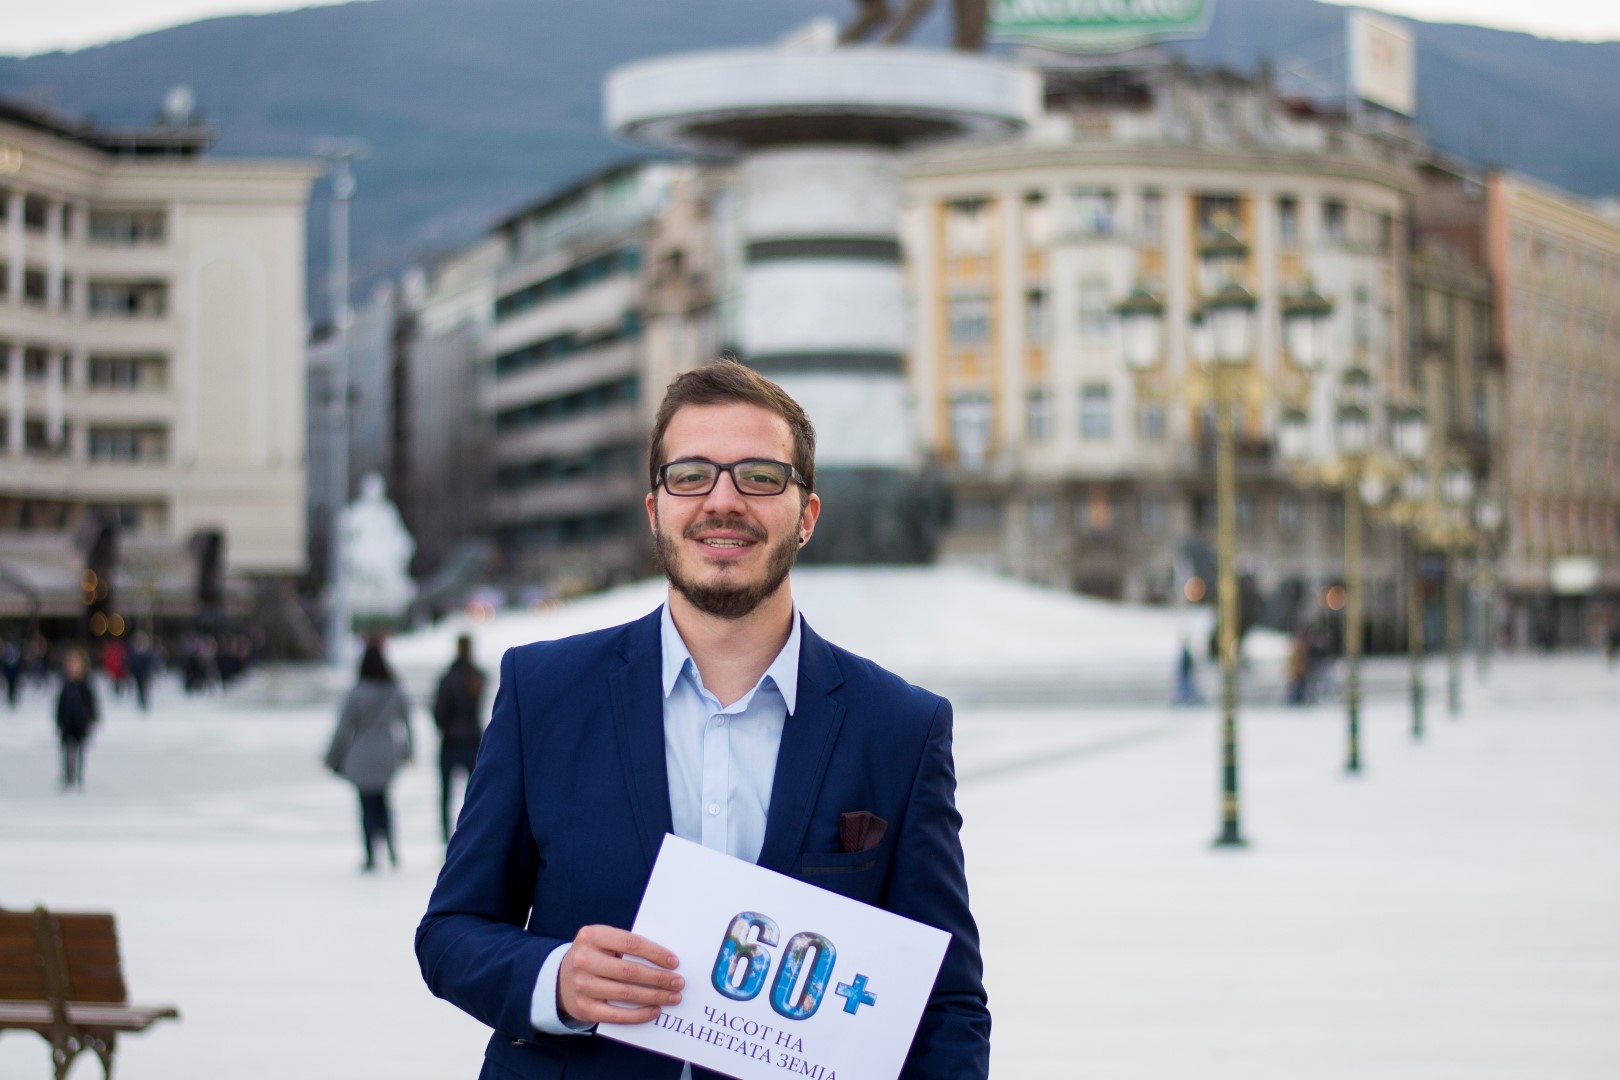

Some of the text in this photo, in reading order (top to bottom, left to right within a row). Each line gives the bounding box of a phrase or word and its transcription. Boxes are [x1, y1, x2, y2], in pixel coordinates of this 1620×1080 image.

[711, 911, 878, 1020] 60+
[654, 1012, 771, 1063] ПЛАНЕТАТА
[704, 1006, 803, 1053] ЧАСОТ НА
